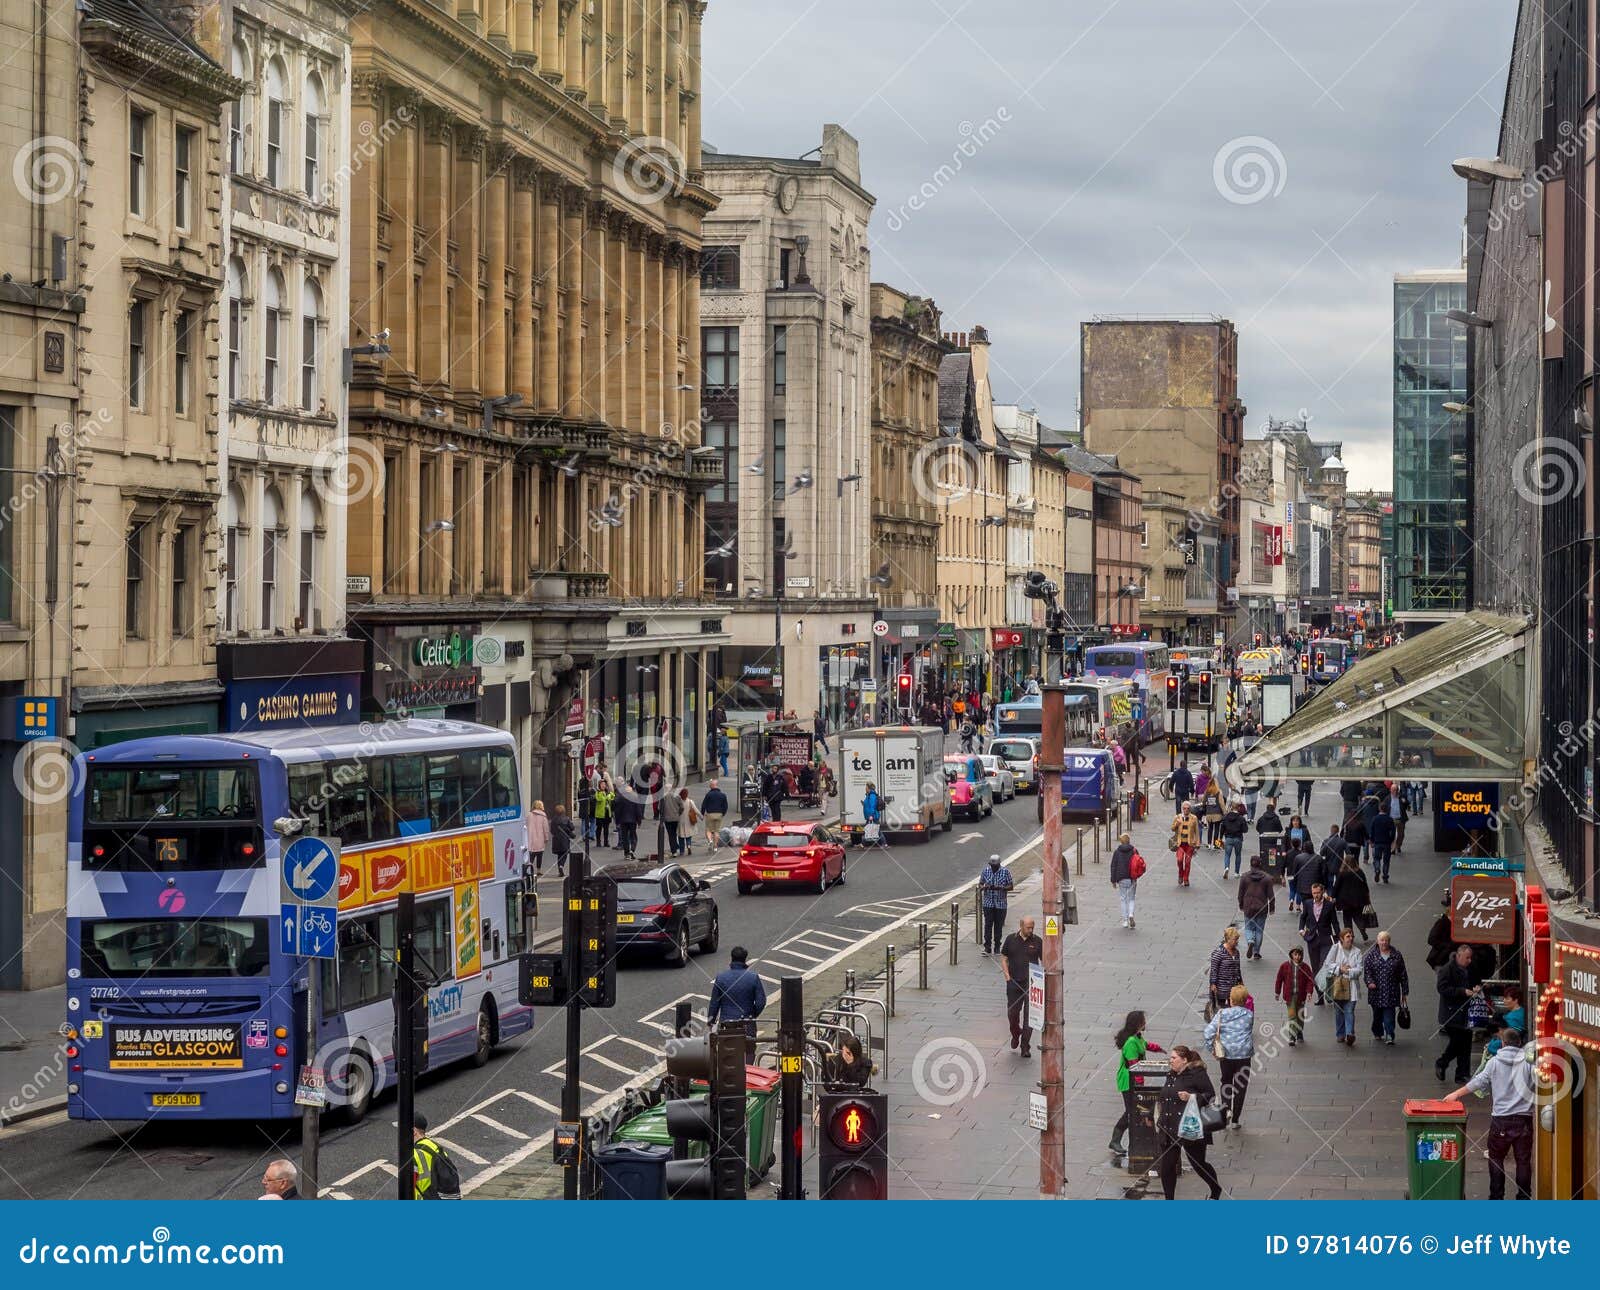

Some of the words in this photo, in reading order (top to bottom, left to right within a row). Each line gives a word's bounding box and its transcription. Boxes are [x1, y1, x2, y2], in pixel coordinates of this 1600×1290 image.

[420, 638, 452, 666] Celtic
[258, 694, 300, 722] CASHINO
[302, 691, 337, 717] GAMING
[1075, 756, 1096, 769] DX
[1453, 791, 1482, 801] Card
[1444, 801, 1491, 815] Factory
[158, 838, 178, 862] 75
[415, 843, 451, 889] LIVE
[462, 837, 493, 881] FULL
[1456, 861, 1504, 870] Poundland
[1456, 890, 1511, 911] Pizza
[1463, 910, 1504, 929] Hut
[591, 940, 597, 950] 2
[534, 977, 547, 987] 36
[590, 979, 597, 988] 3
[1571, 969, 1597, 995] COME
[91, 987, 119, 998] 37742
[140, 988, 207, 996] www.firstgroup.com
[1564, 998, 1575, 1020] TO
[116, 1030, 141, 1042] BUS
[143, 1029, 235, 1042] ADVERTISING
[153, 1042, 235, 1056] GLASGOW
[783, 1058, 800, 1072] 13
[302, 1077, 325, 1088] YOU
[156, 1095, 178, 1105] SF09
[557, 1137, 575, 1145] WAIT
